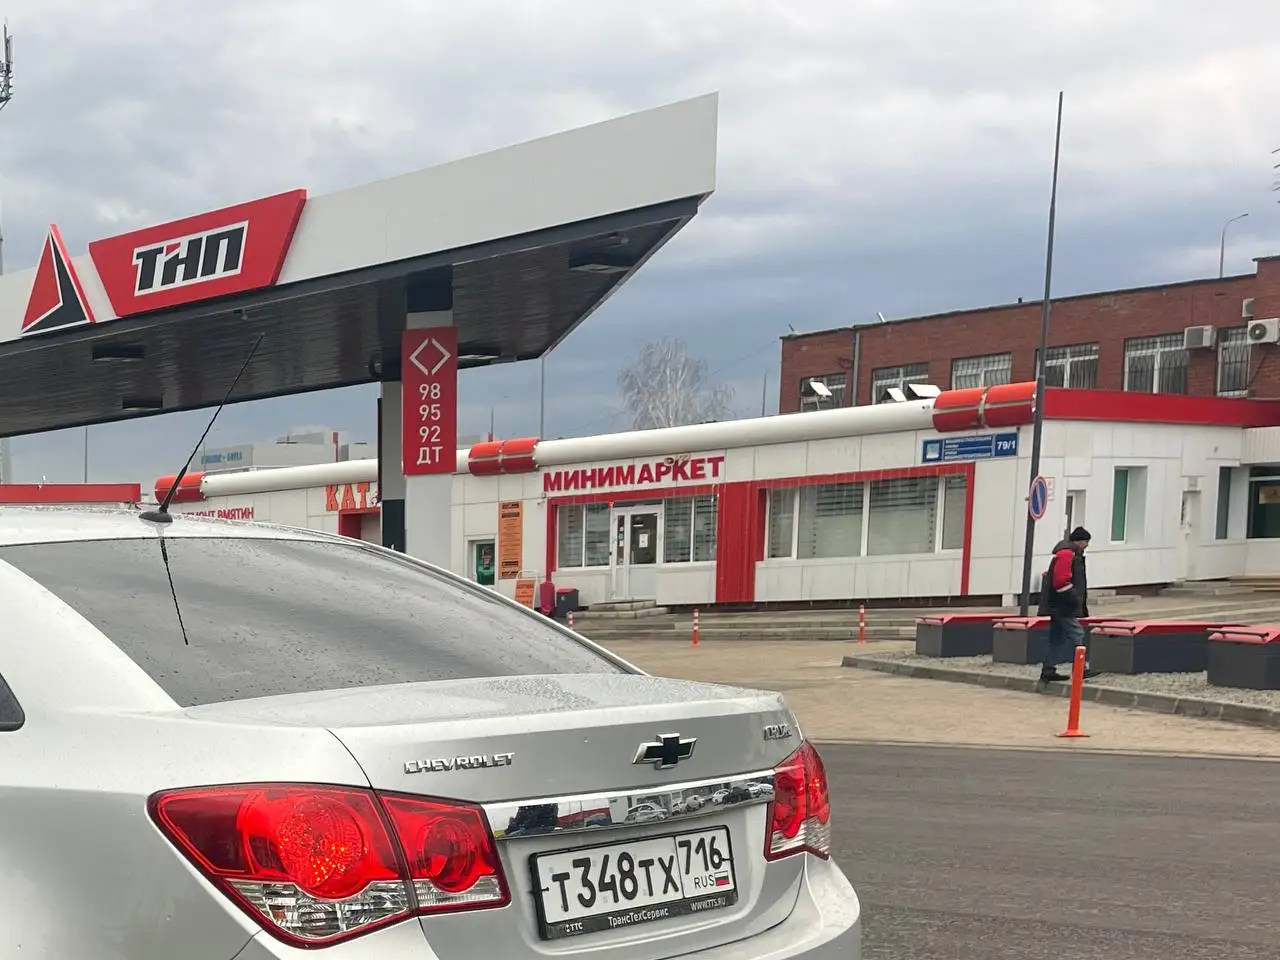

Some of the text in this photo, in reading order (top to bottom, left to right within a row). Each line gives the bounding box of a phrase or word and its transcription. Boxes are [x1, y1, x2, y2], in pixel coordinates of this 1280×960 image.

[134, 223, 247, 294] ТНП
[419, 383, 441, 400] 98
[419, 404, 441, 421] 95
[419, 425, 441, 443] 92
[996, 440, 1016, 450] 79/1
[416, 446, 444, 466] ДТ
[543, 456, 725, 492] МИНИМАРКЕТ
[403, 752, 516, 775] CHEVROLET
[678, 836, 724, 875] 716
[694, 874, 716, 889] RUS
[608, 908, 669, 928] ТрансТехСервис
